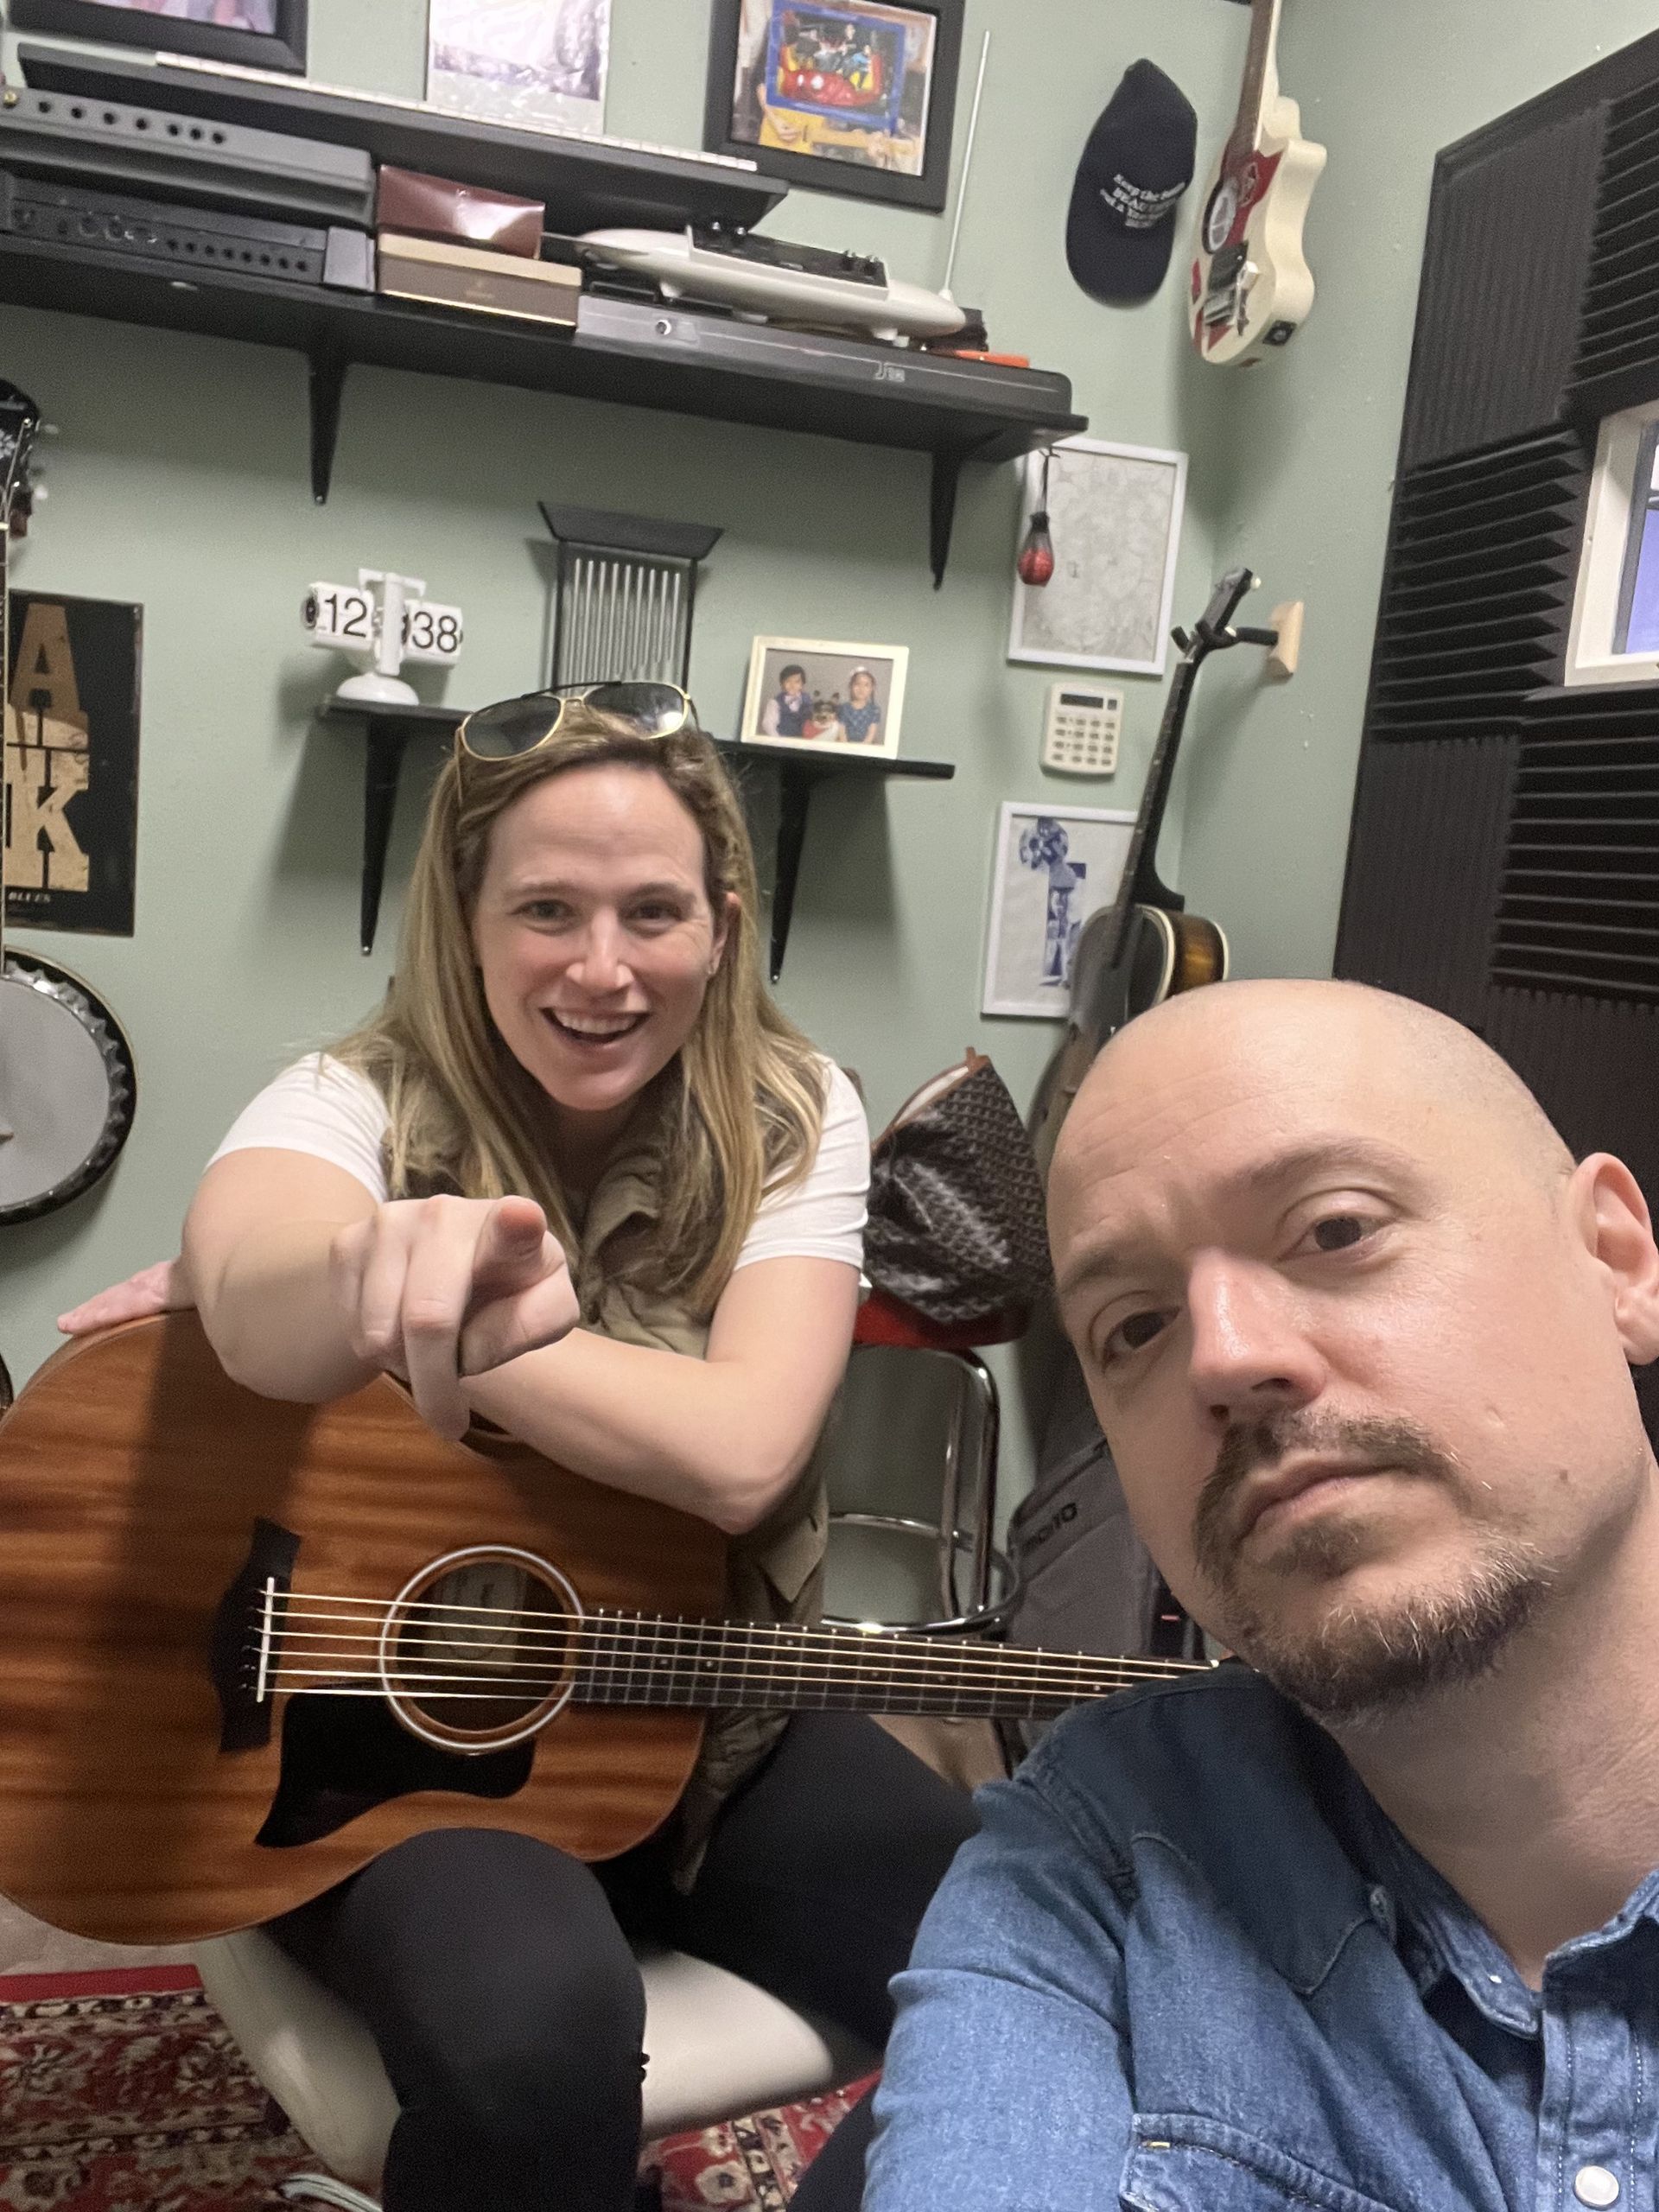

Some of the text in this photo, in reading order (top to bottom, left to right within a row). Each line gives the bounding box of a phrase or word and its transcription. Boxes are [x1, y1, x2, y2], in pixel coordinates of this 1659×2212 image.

[7, 602, 89, 749] A
[325, 594, 457, 652] 12 38
[6, 746, 89, 891] K
